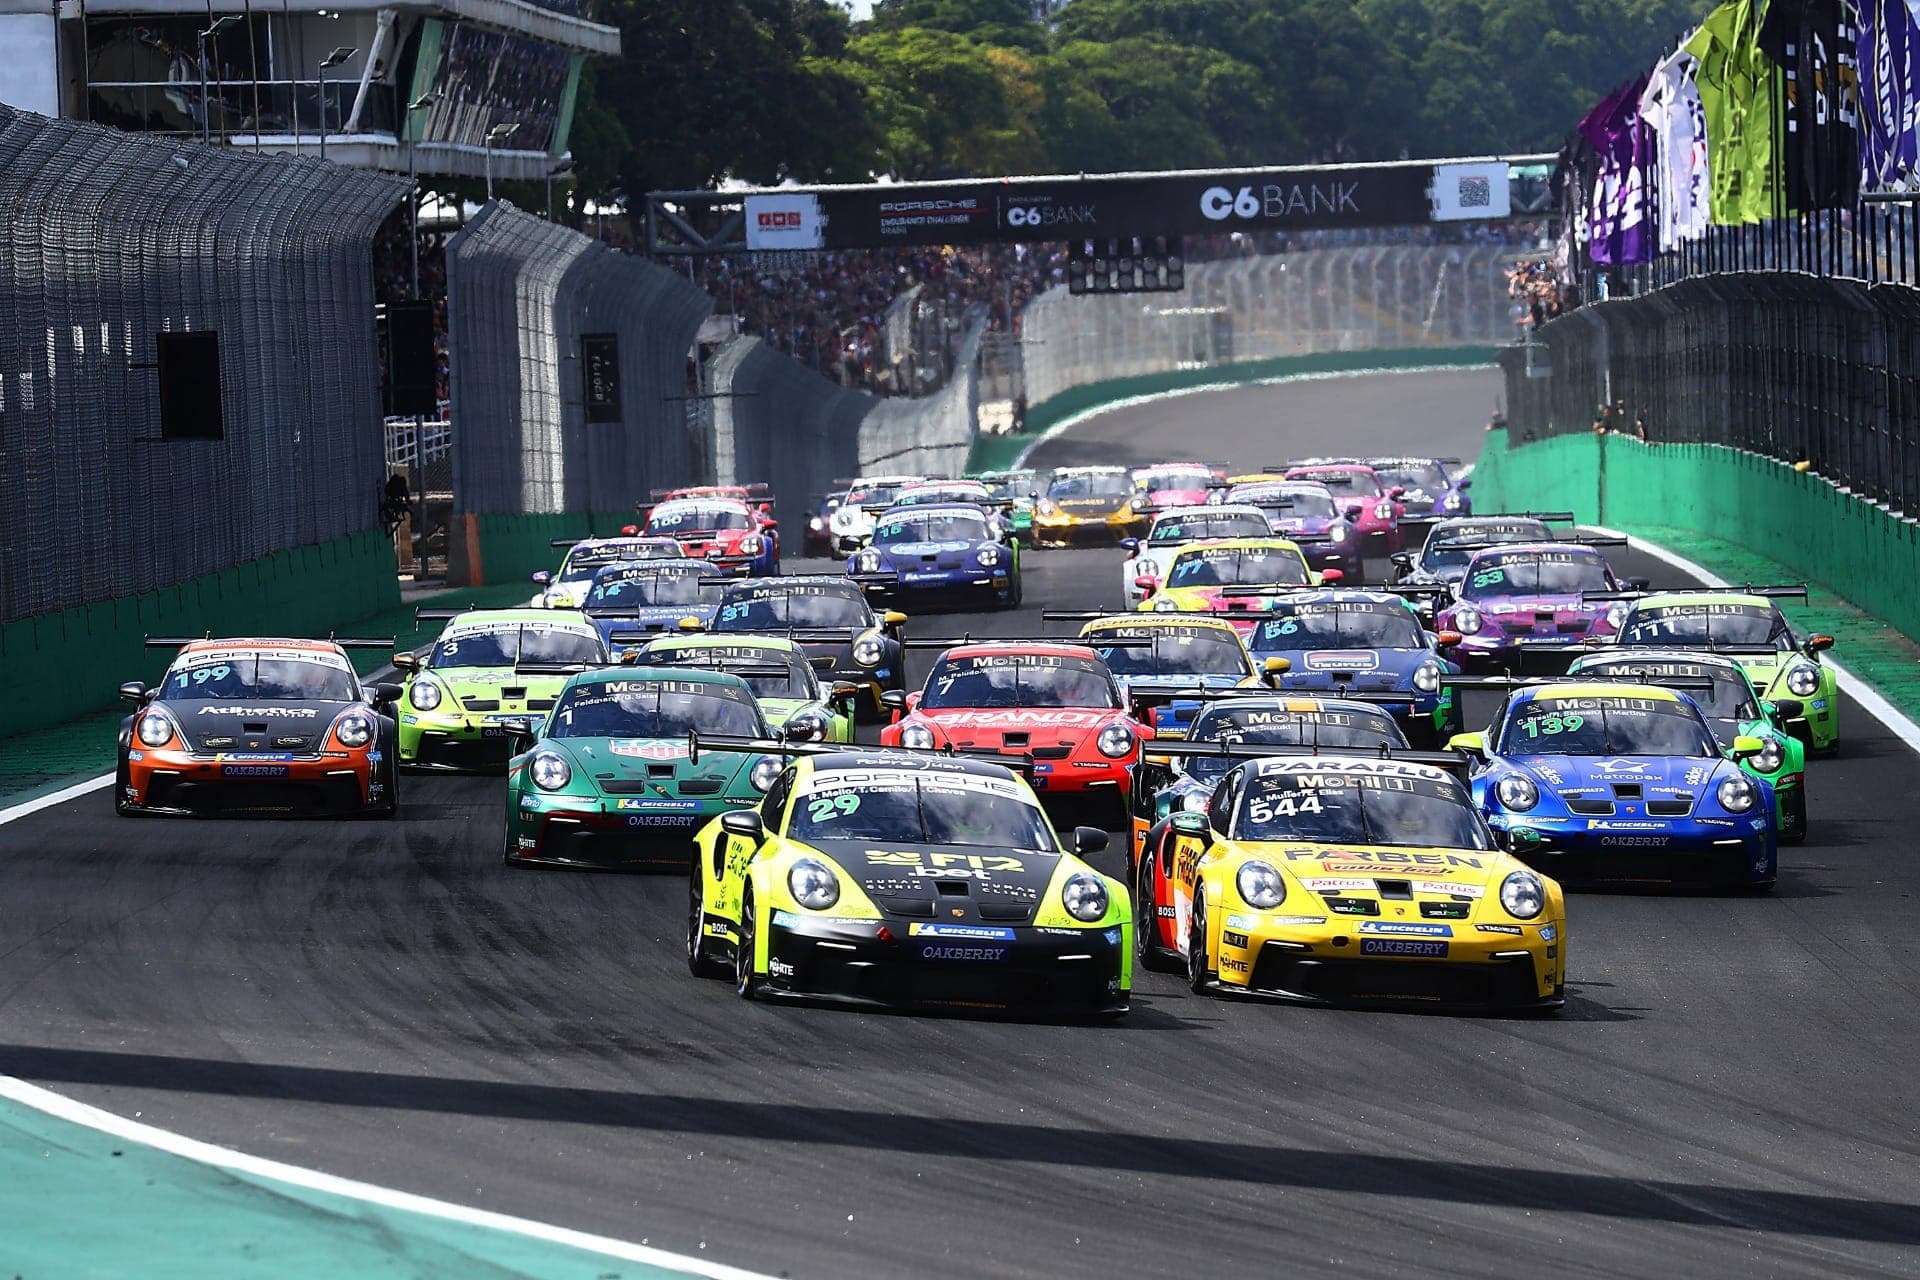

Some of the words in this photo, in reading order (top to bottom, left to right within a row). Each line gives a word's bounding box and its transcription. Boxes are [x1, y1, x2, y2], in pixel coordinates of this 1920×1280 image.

[880, 199, 977, 212] PORSCHE
[1629, 622, 1676, 641] 111
[442, 642, 459, 656] 3
[189, 652, 340, 665] PORSCHE
[973, 656, 1036, 667] Mobil
[175, 666, 231, 688] 199
[605, 681, 675, 693] Mobil
[937, 678, 954, 696] 7
[1556, 699, 1627, 711] Mobil
[559, 710, 573, 725] 1
[1249, 713, 1320, 724] Mobil
[1522, 716, 1584, 738] 139
[225, 766, 286, 777] OAKBERRY
[1263, 762, 1442, 779] PARAFLU
[1297, 775, 1380, 789] Mobil
[1590, 774, 1663, 782] Metropax
[814, 774, 1018, 797] PORSCHE
[807, 794, 860, 823] 29
[1251, 797, 1324, 824] 544
[629, 816, 695, 827] OAKBERRY
[1601, 836, 1669, 846] OAKBERRY
[930, 852, 1025, 872] F12
[1284, 850, 1483, 868] FARBEN
[908, 866, 992, 880] .bet
[1311, 878, 1365, 886] Patrus
[1422, 882, 1477, 894] Patrus
[1158, 907, 1175, 917] BOSS
[712, 922, 728, 933] BOSS
[939, 927, 1006, 937] MICHELIN
[1380, 926, 1443, 934] MICHELIN
[922, 946, 1005, 960] OAKBERRY
[1366, 941, 1443, 955] OAKBERRY
